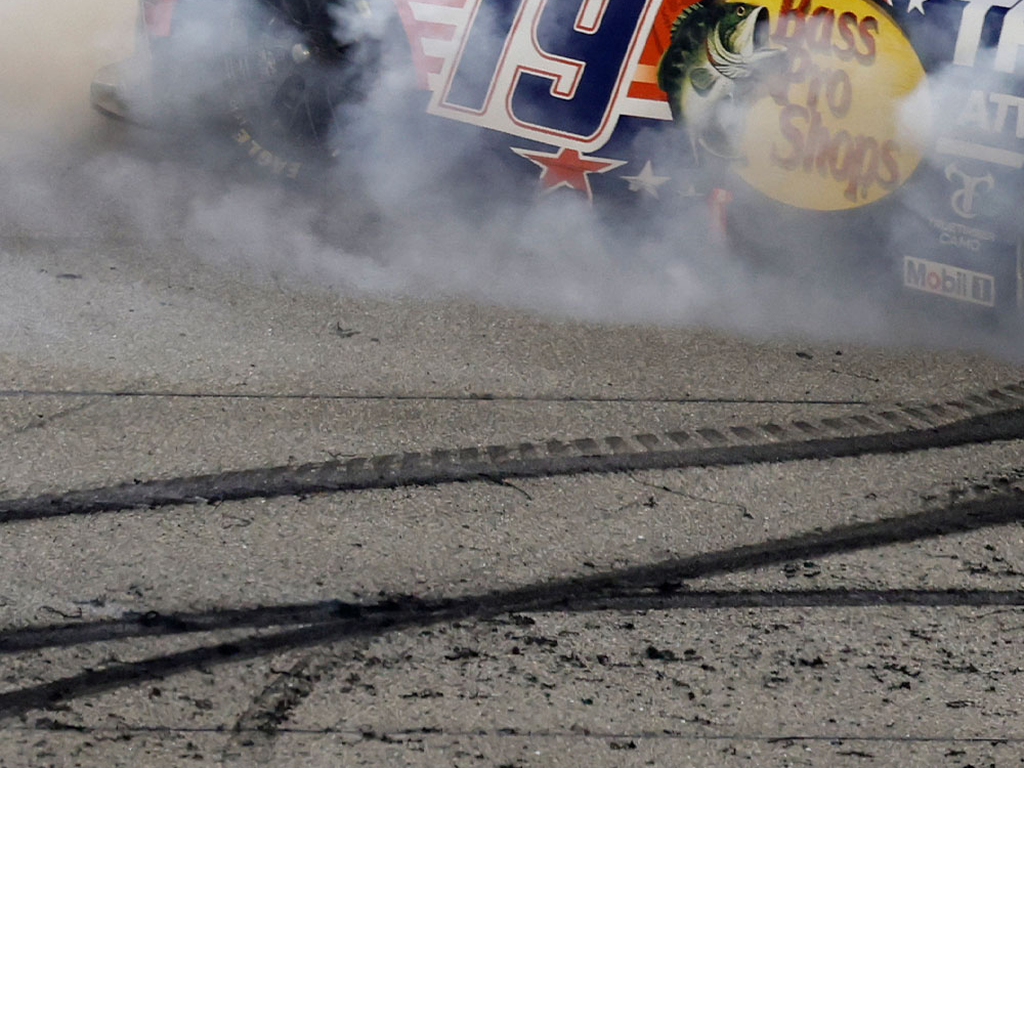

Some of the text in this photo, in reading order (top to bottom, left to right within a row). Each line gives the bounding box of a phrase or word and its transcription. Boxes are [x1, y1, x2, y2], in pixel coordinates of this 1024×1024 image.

[767, 53, 852, 119] Pro
[770, 102, 902, 202] Shops
[906, 260, 968, 297] Mobil
